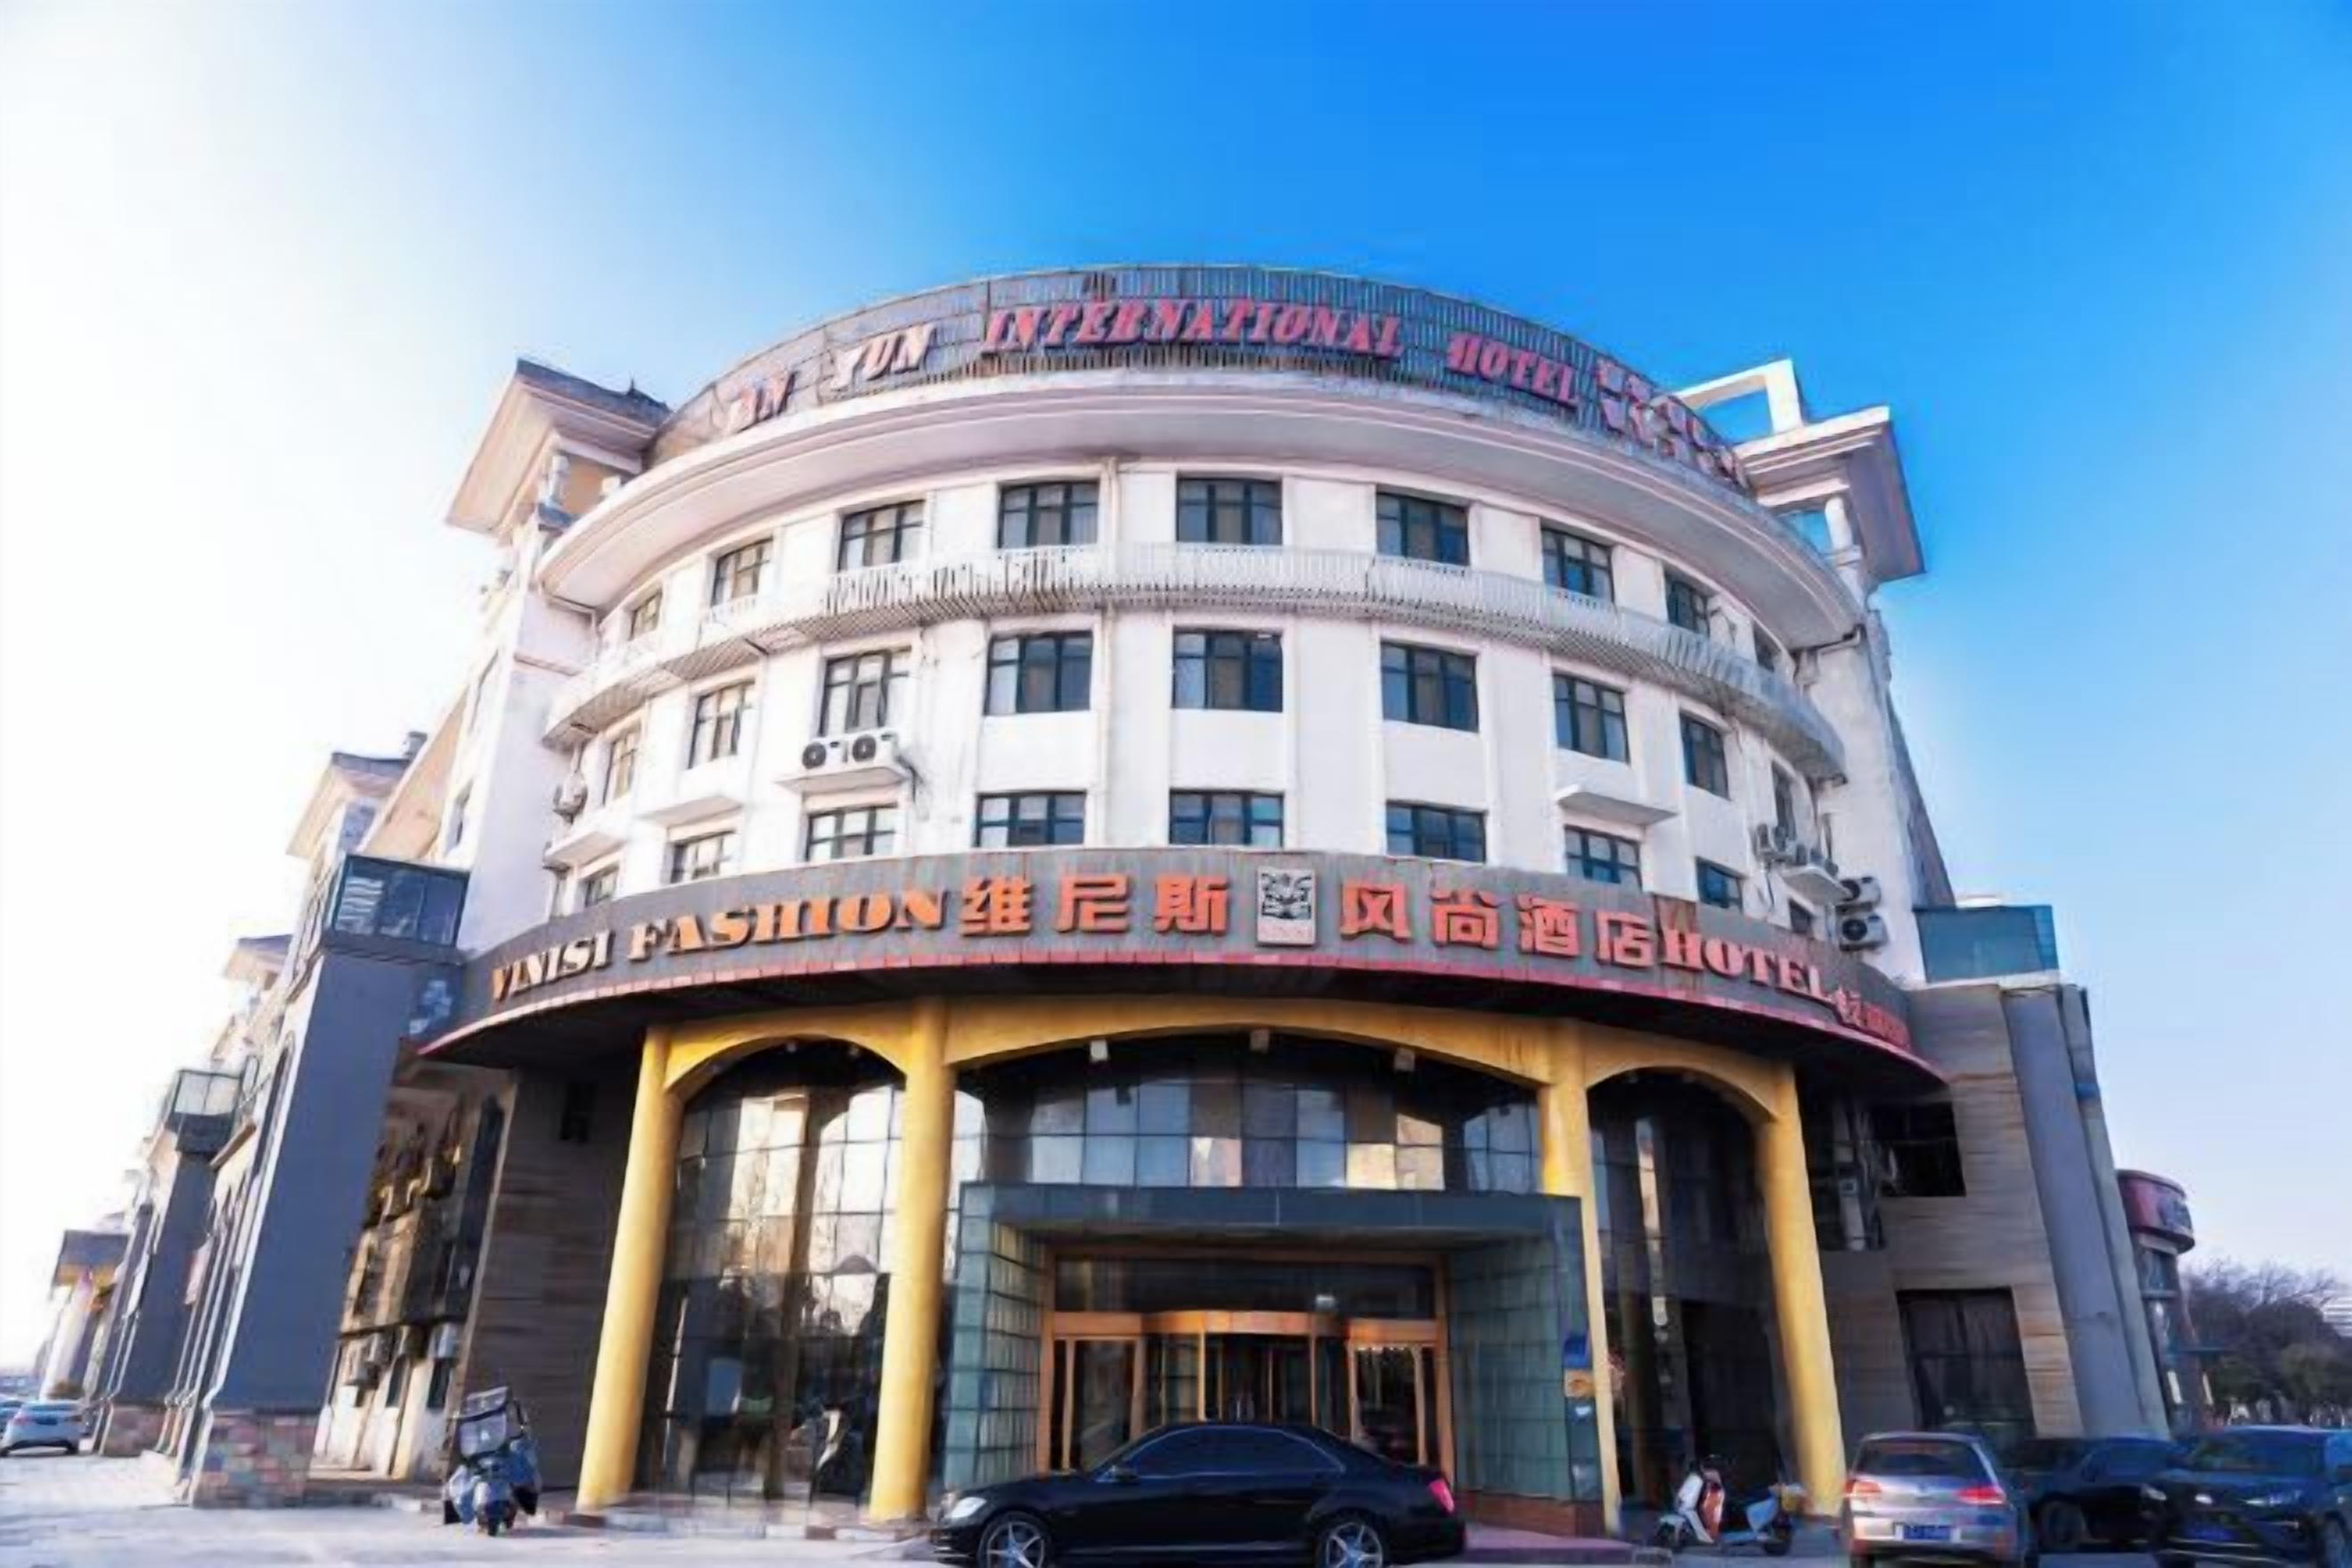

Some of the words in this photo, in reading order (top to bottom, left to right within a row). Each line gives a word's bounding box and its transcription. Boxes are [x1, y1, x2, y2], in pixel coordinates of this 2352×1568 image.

[980, 298, 1404, 360] INTERNATIONAL
[1445, 330, 1580, 408] HOTEL
[490, 928, 617, 1001] VINISI
[627, 887, 950, 962] FASHION
[959, 873, 1231, 937] 维尼斯
[1338, 880, 1655, 969] 风尚酒店
[1661, 928, 1833, 1005] HOTEL
